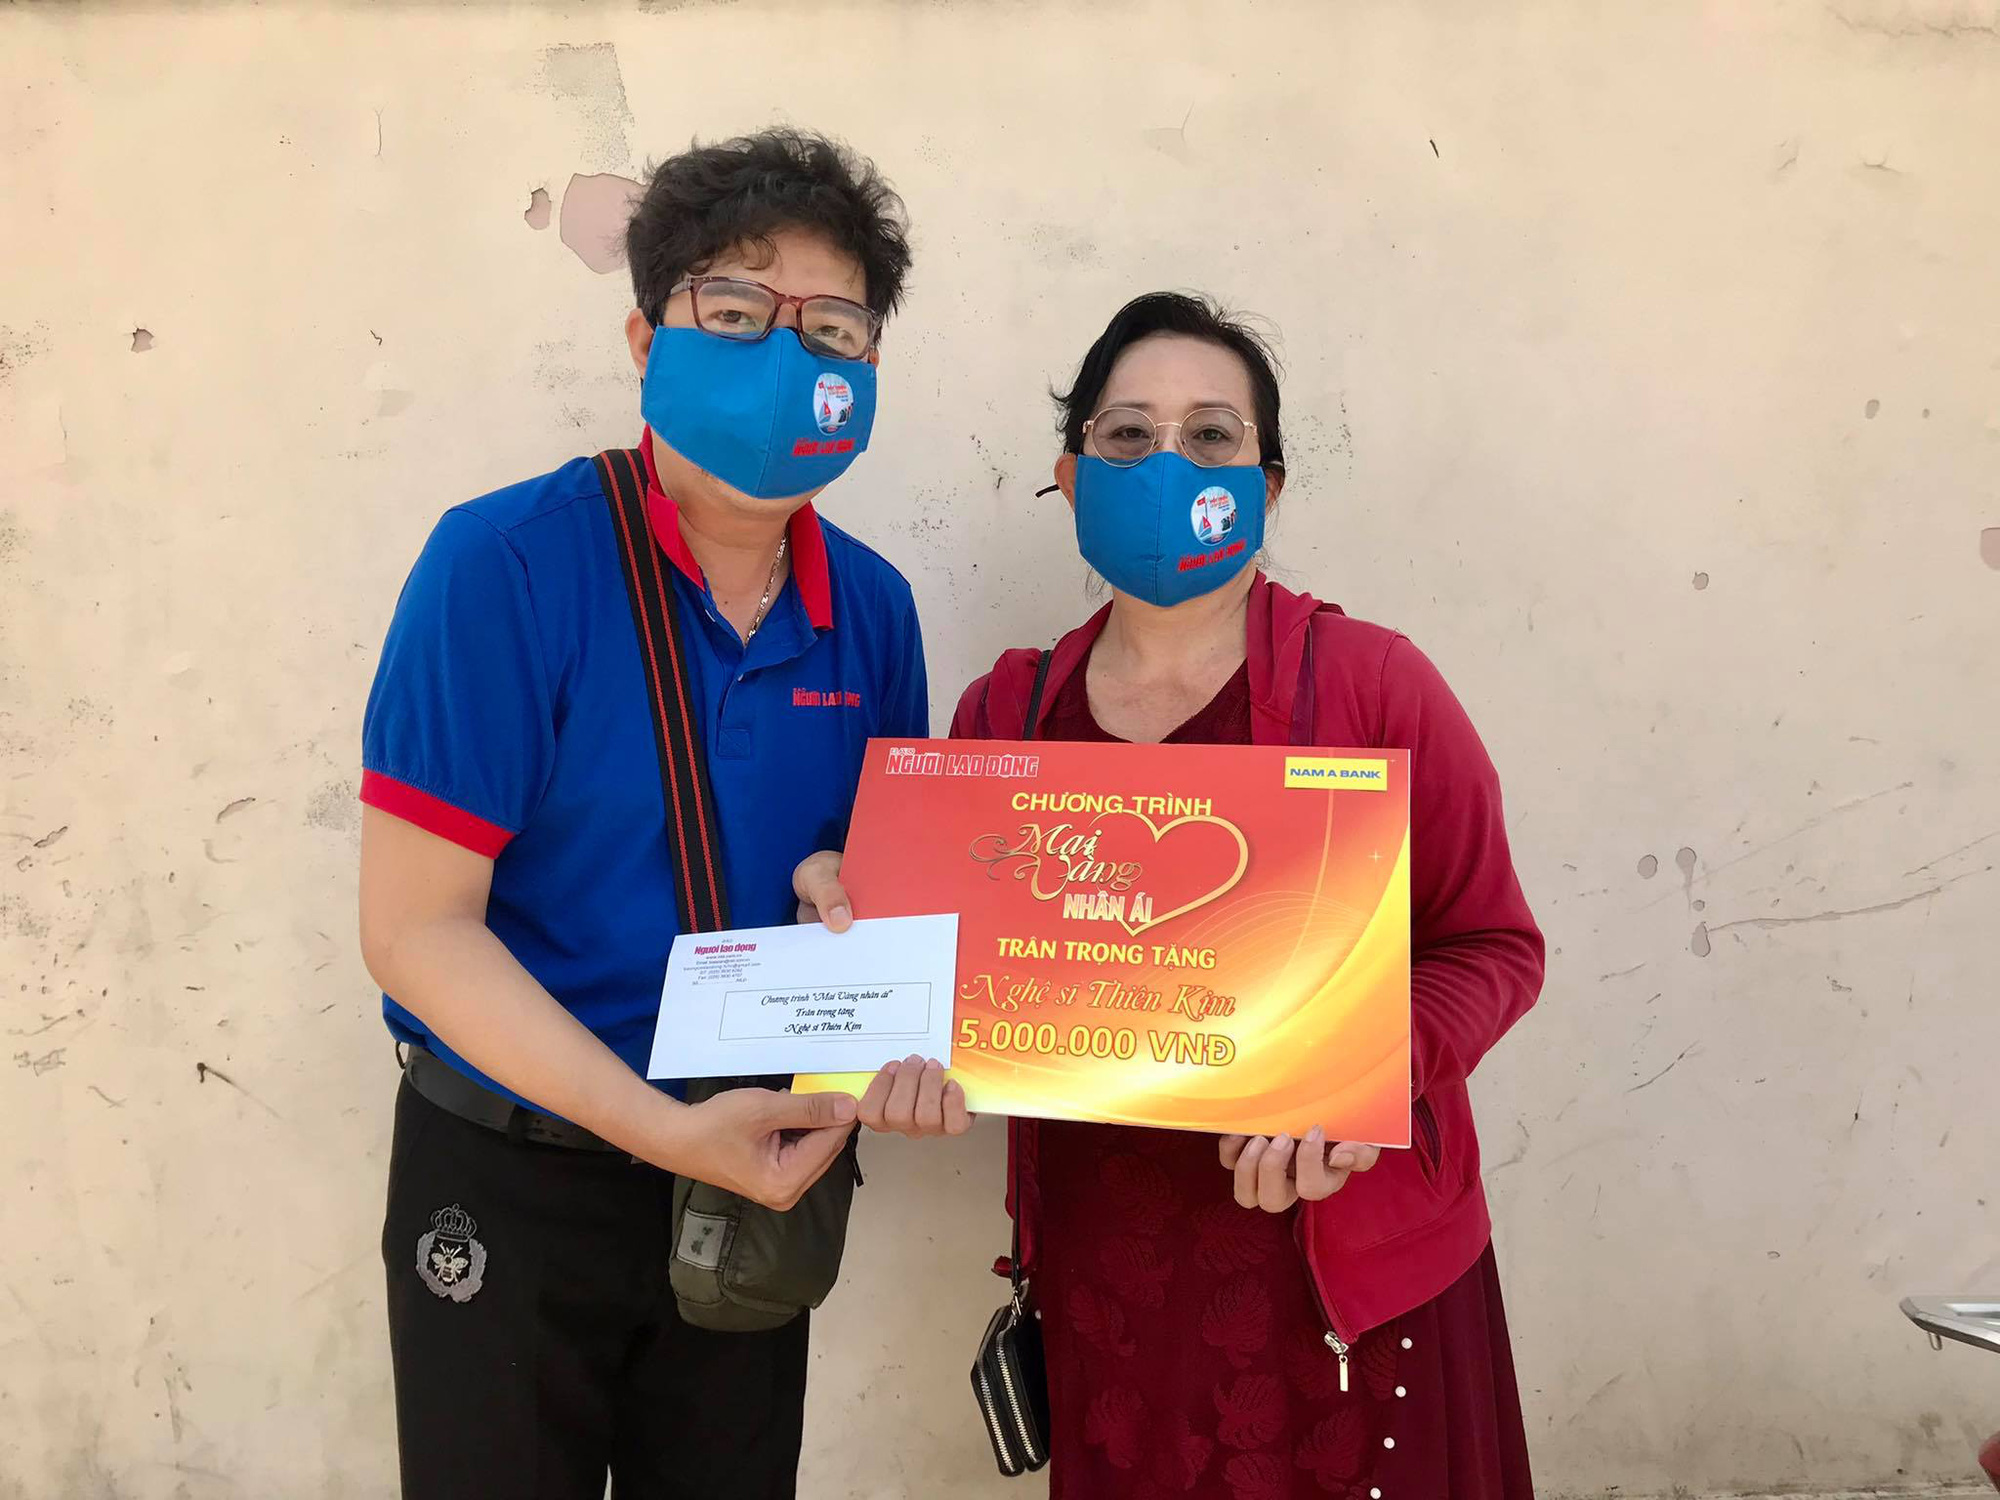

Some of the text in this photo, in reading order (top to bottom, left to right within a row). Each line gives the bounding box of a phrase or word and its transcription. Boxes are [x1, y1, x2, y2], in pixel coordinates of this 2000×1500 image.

[885, 752, 1040, 779] NGƯỜI LAO ĐỘNG
[1290, 768, 1381, 779] NAM A BANK
[1011, 791, 1212, 816] CHƯƠNG TRÌNH
[975, 823, 1103, 858] Mai
[1010, 852, 1142, 901] Vàng
[1062, 890, 1153, 923] NHÂN ÁI
[997, 936, 1217, 970] TRÂN TRỌNG TẶNG
[959, 974, 1236, 1022] Nghệ sĩ Thiên Kim
[843, 1021, 862, 1033] Kim
[957, 1018, 1236, 1067] 5.000.000 VNĐ
